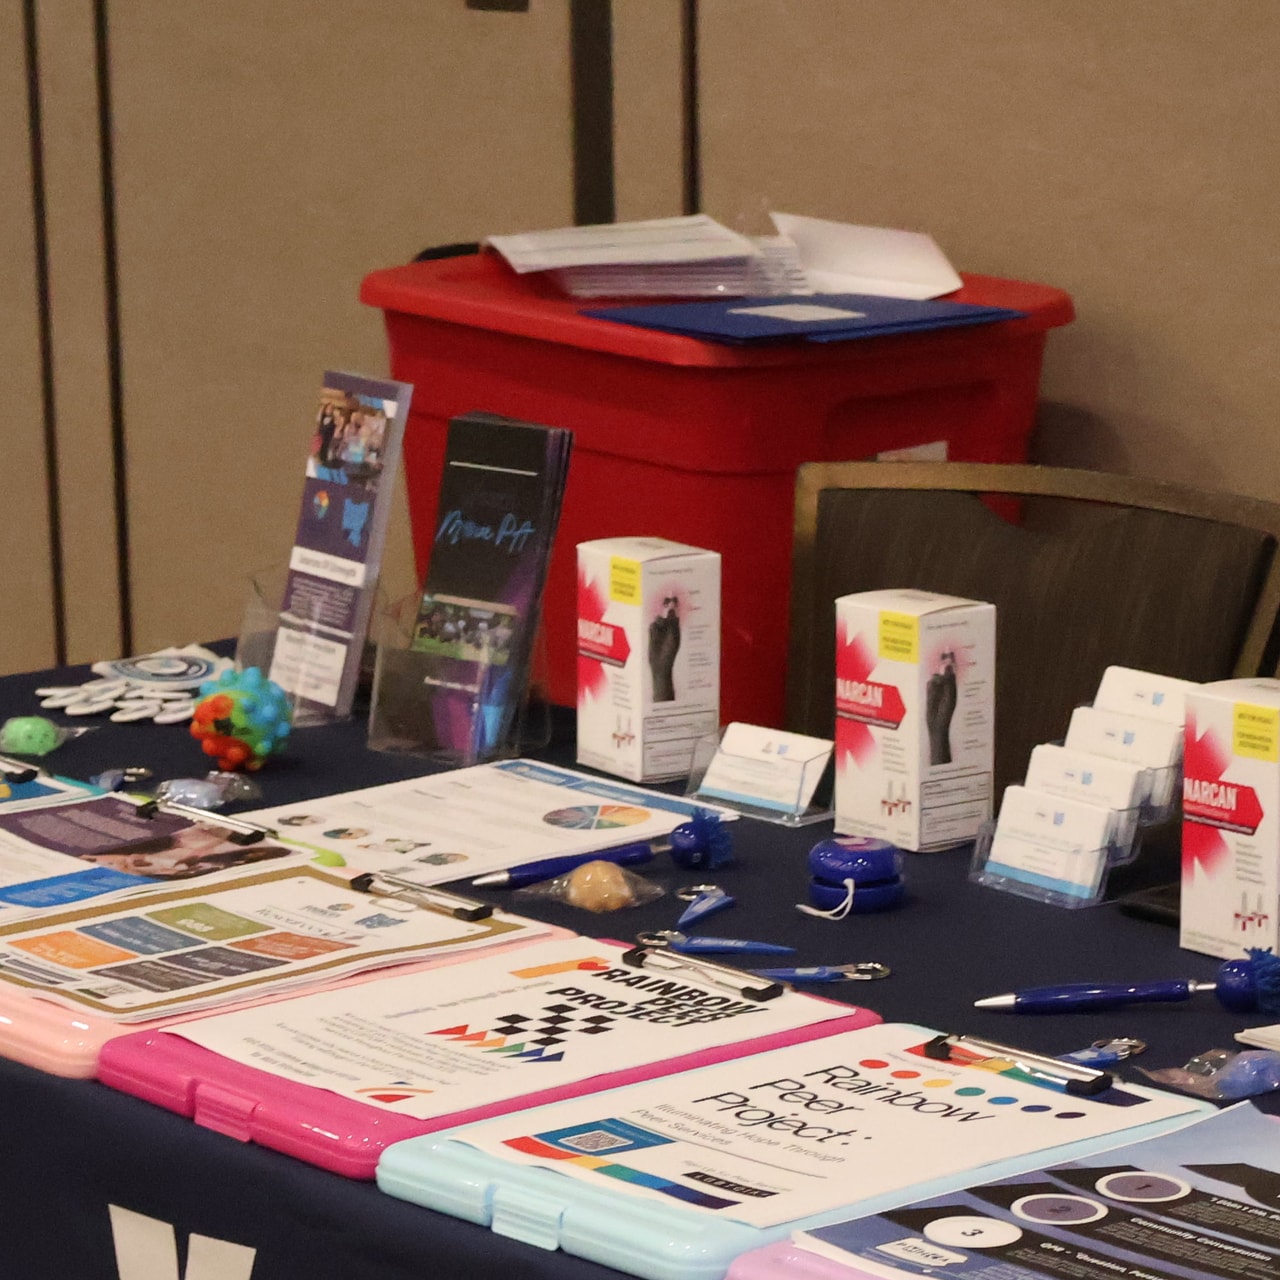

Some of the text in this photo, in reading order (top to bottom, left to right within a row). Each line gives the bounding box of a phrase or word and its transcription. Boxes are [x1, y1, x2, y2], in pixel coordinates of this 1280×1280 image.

[1184, 778, 1237, 811] NARCAN
[546, 985, 702, 1027] PROJECT
[591, 969, 770, 1016] RAINBOW
[636, 996, 737, 1023] PEER
[749, 1078, 864, 1115] Peer
[804, 1065, 995, 1122] Rainbow
[632, 1109, 733, 1146] Peer Services
[653, 1104, 846, 1164] Illuminating Hope Through
[692, 1092, 873, 1146] Project:
[961, 1228, 984, 1237] 3
[1124, 1217, 1277, 1261] Community Conversation
